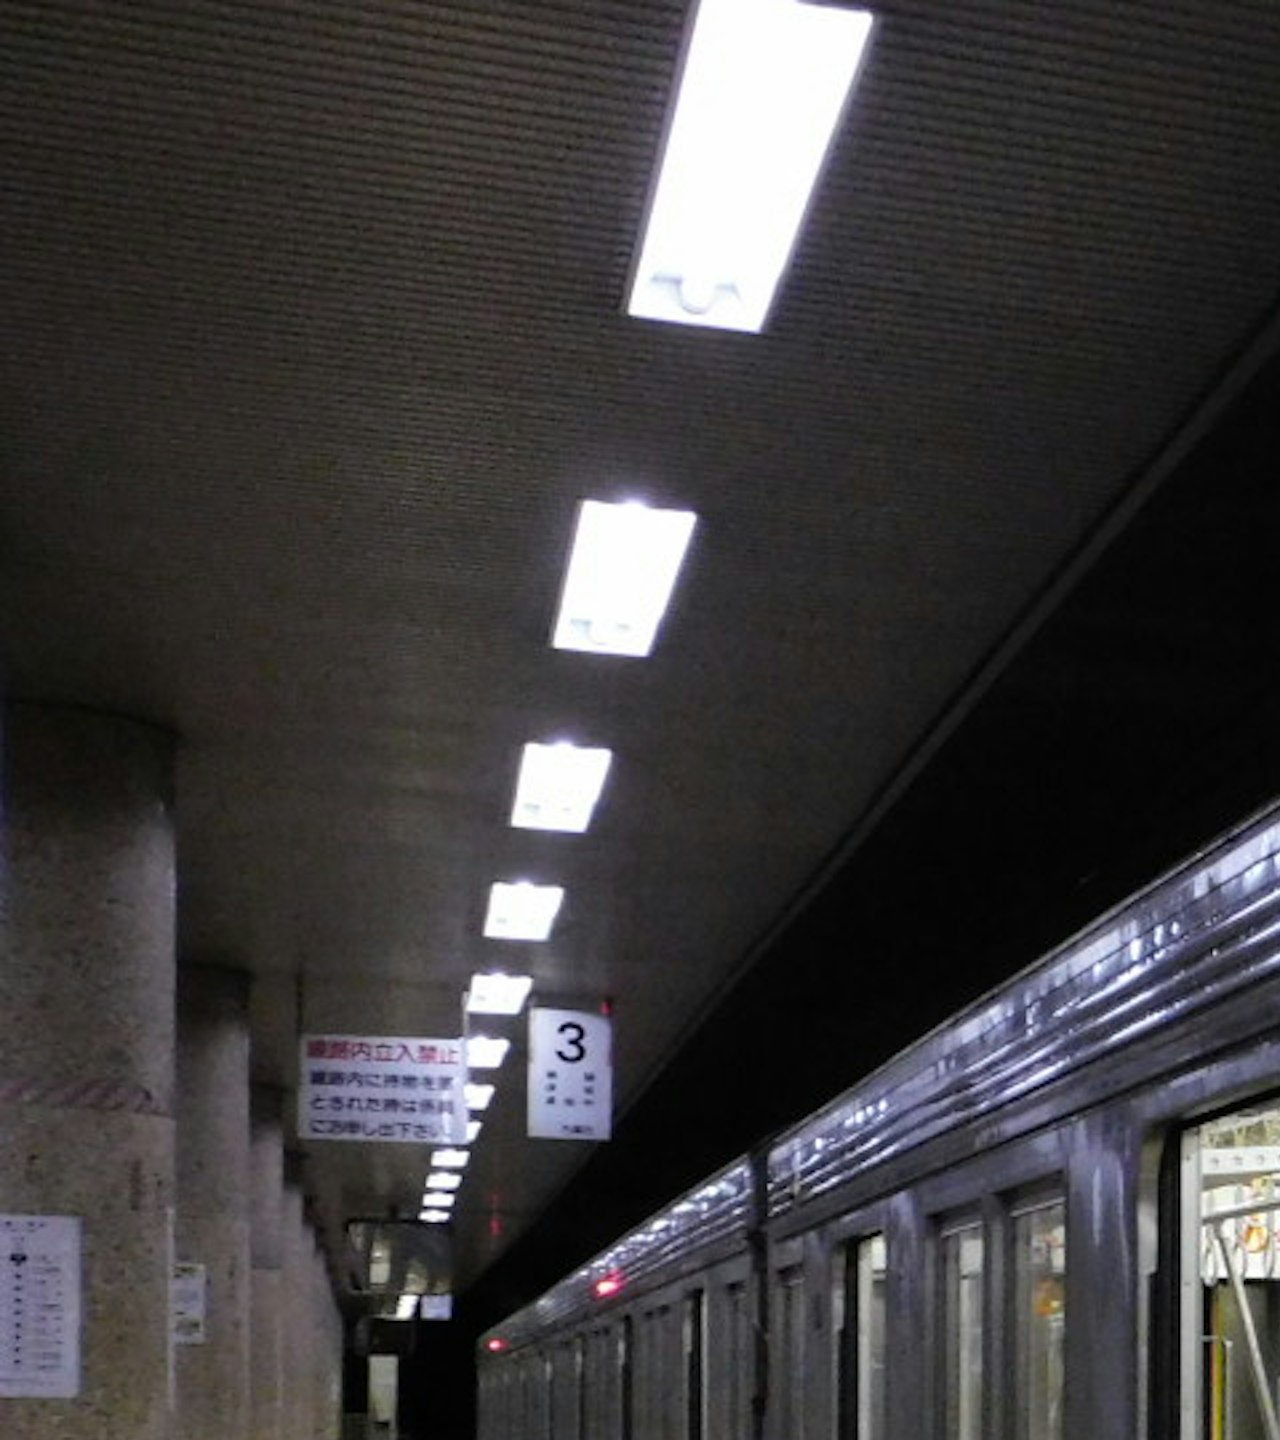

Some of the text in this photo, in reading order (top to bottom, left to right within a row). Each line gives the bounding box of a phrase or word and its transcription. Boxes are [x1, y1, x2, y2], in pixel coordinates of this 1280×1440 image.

[306, 1039, 459, 1065] 線路内立入禁止
[556, 1022, 586, 1063] 3
